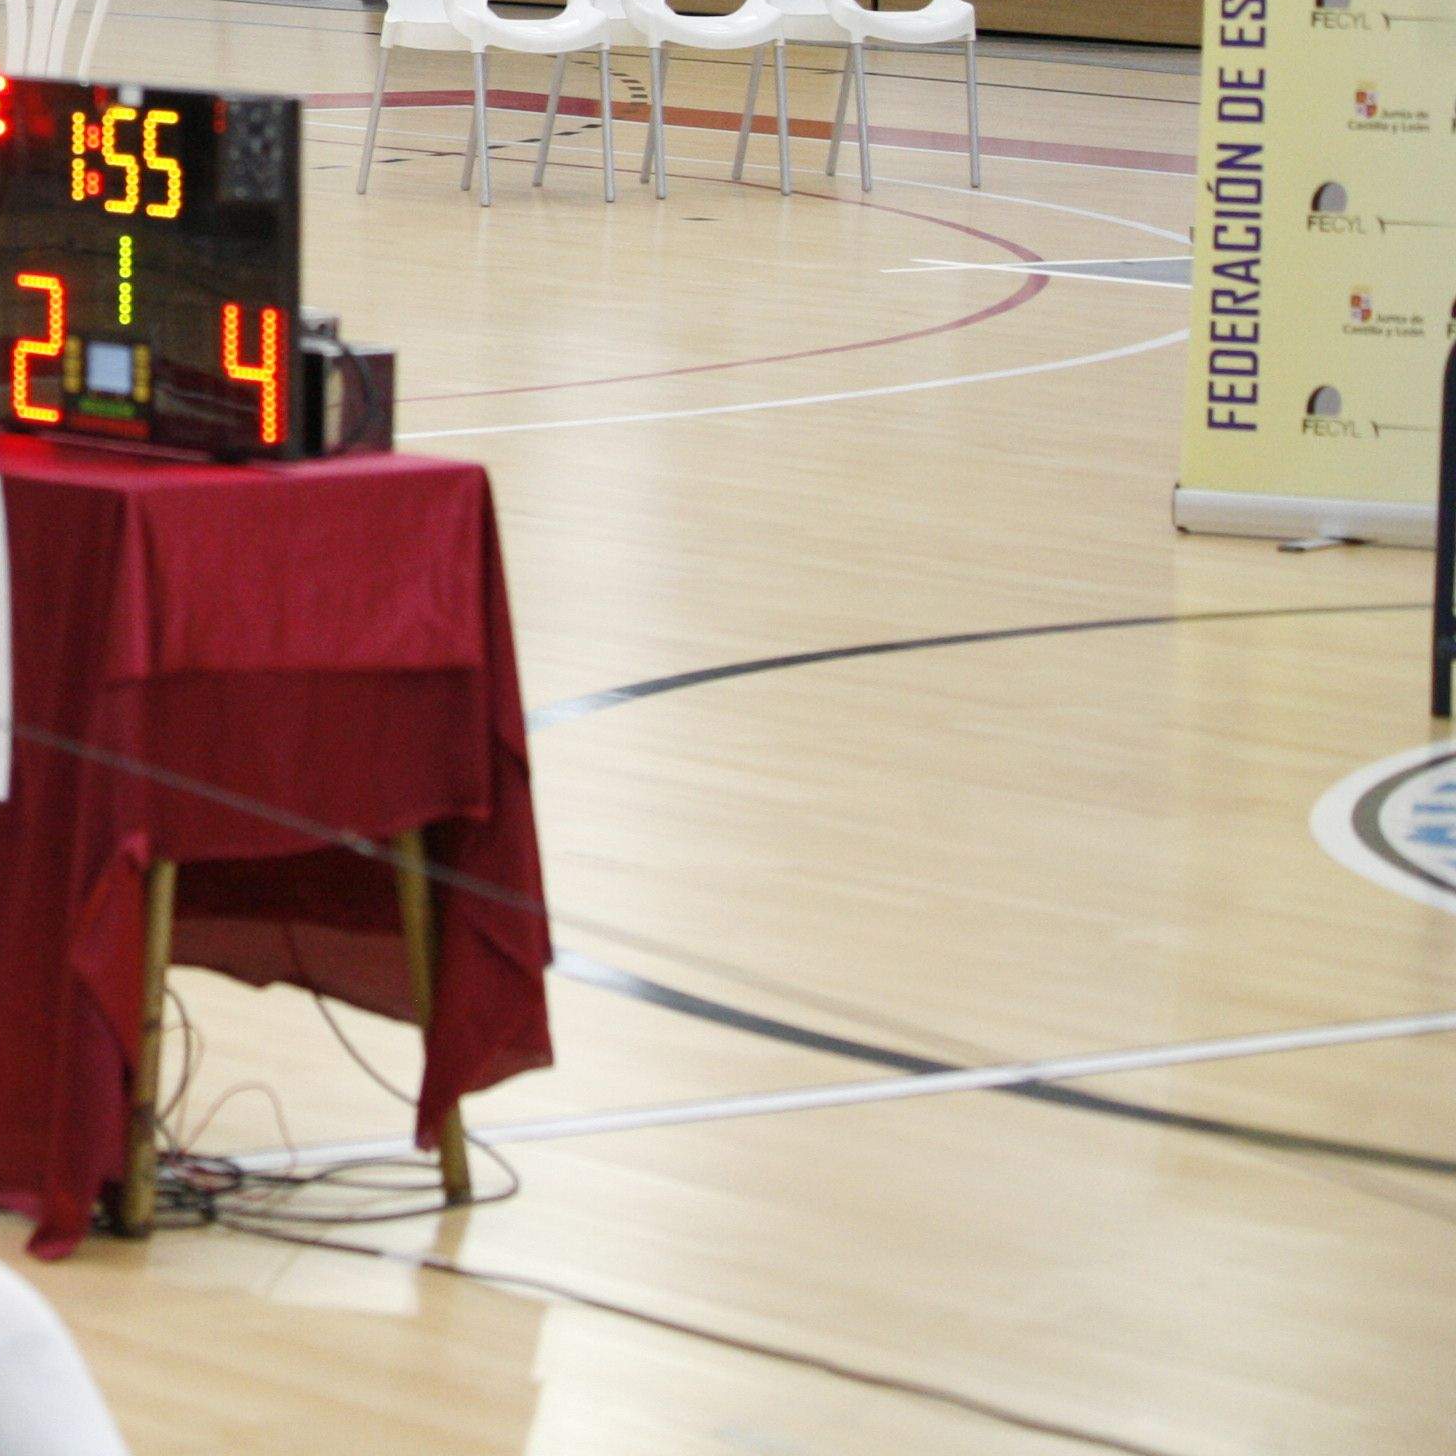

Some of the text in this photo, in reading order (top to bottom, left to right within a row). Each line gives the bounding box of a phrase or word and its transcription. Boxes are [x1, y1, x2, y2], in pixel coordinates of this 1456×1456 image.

[1217, 67, 1265, 123] DE
[11, 273, 281, 444] 2 4
[1206, 143, 1264, 431] FEDERACIÓN
